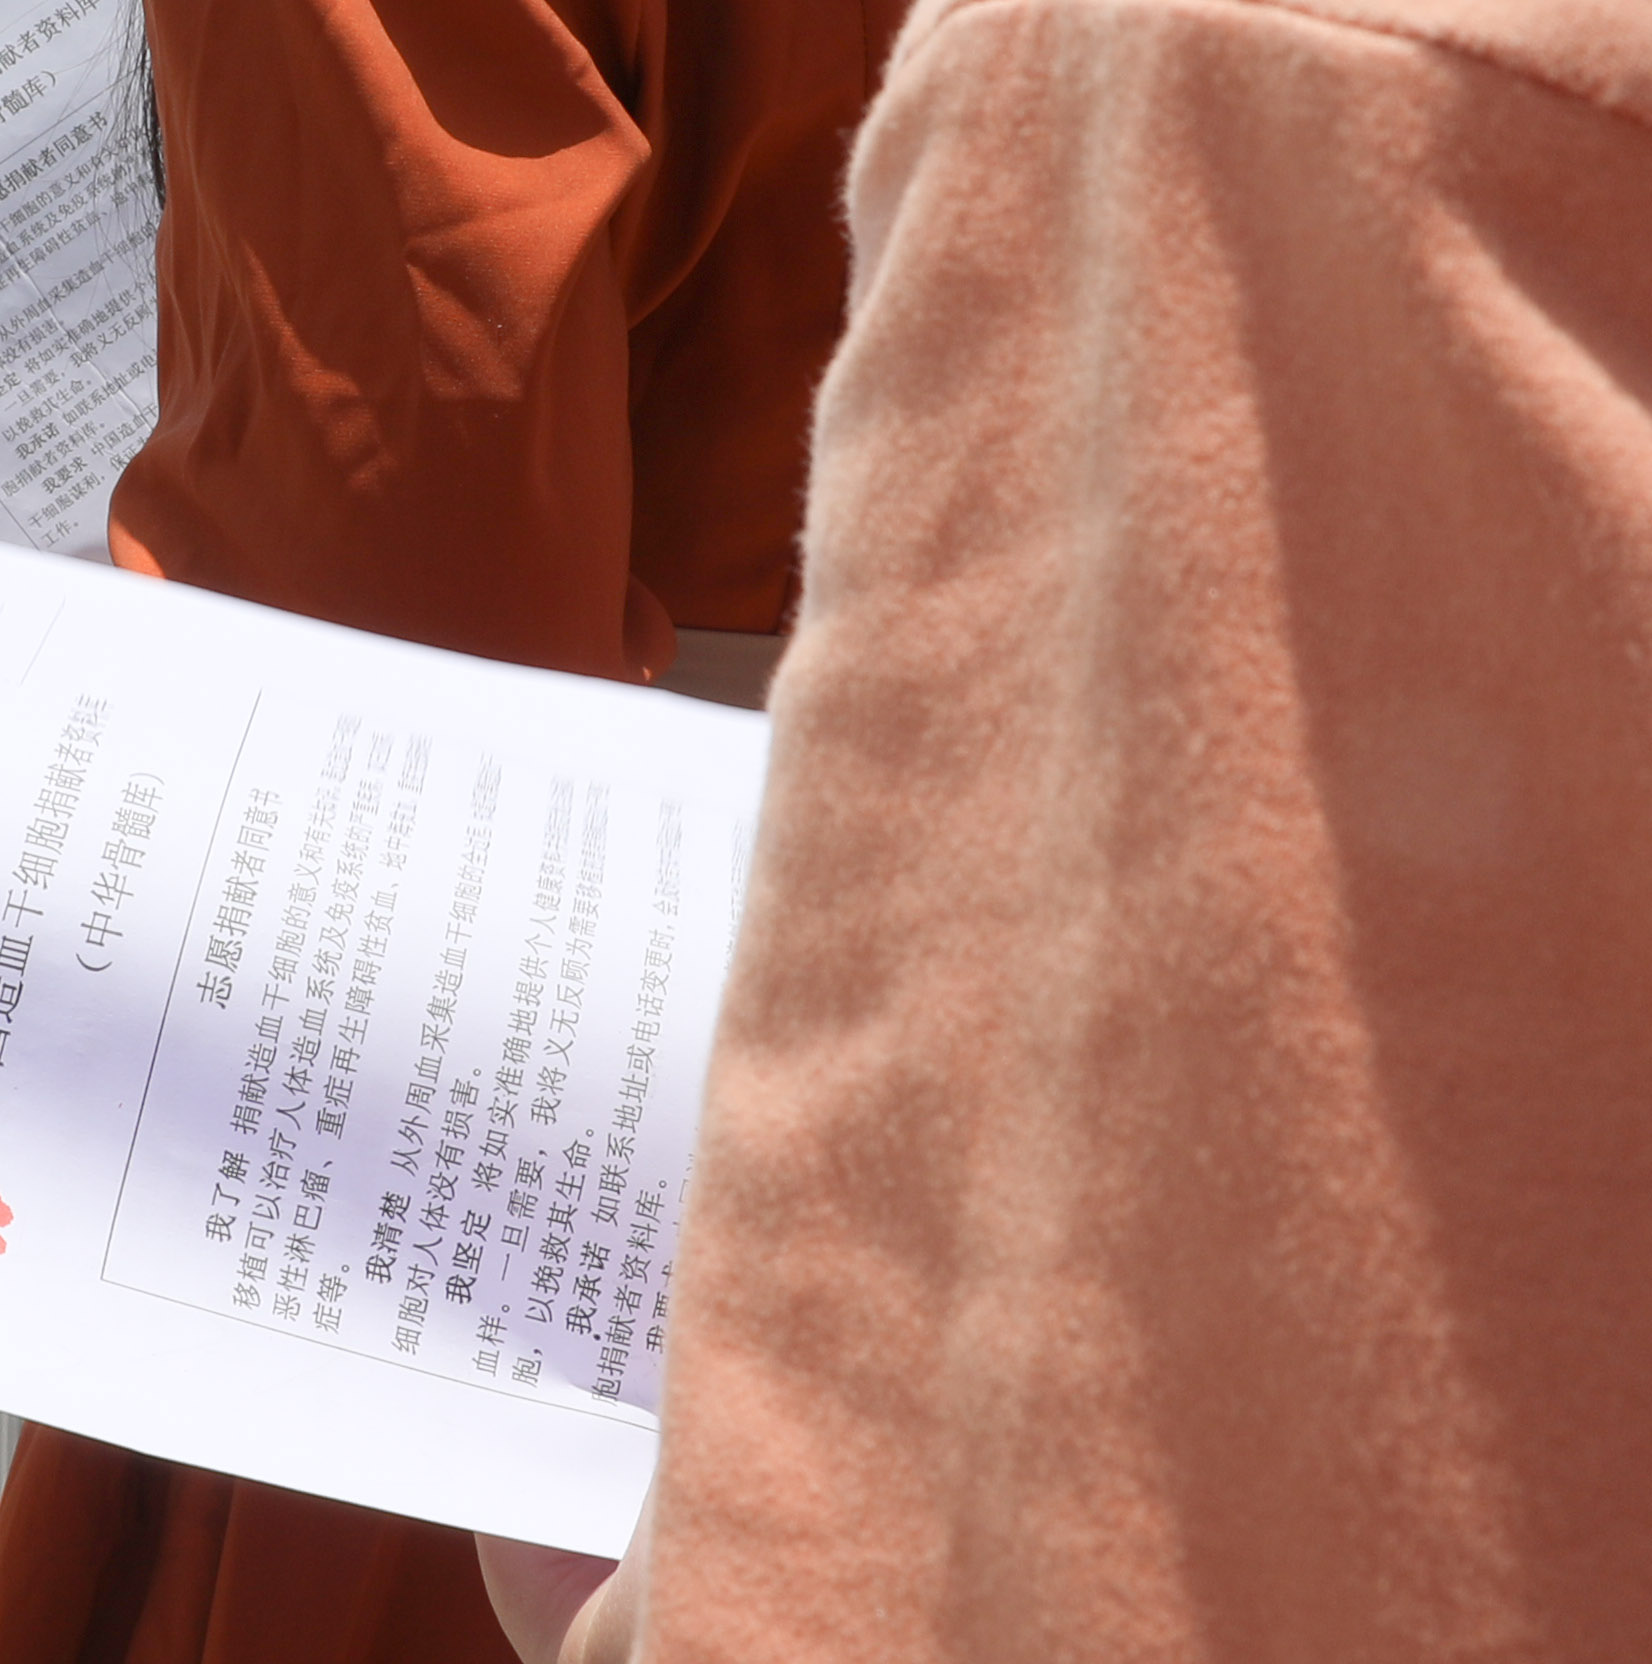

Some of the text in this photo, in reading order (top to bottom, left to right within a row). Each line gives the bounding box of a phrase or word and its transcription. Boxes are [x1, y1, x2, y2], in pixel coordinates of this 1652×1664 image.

[12, 420, 62, 462] 我承诺
[40, 454, 89, 495] 我要求
[38, 512, 82, 549] 工作。
[191, 784, 285, 1011] 志愿捐献者同意书
[202, 1147, 254, 1245] 我了解
[361, 1187, 413, 1286] 我清楚
[390, 1058, 484, 1356] 细胞对人体没有损害。
[309, 1254, 355, 1334] 症等。
[442, 1205, 494, 1307] 我坚定
[507, 1117, 598, 1388] 胞，以挽救其生命。
[562, 1239, 613, 1338] 我承诺
[589, 1169, 672, 1407] 胞捐献者资料库。
